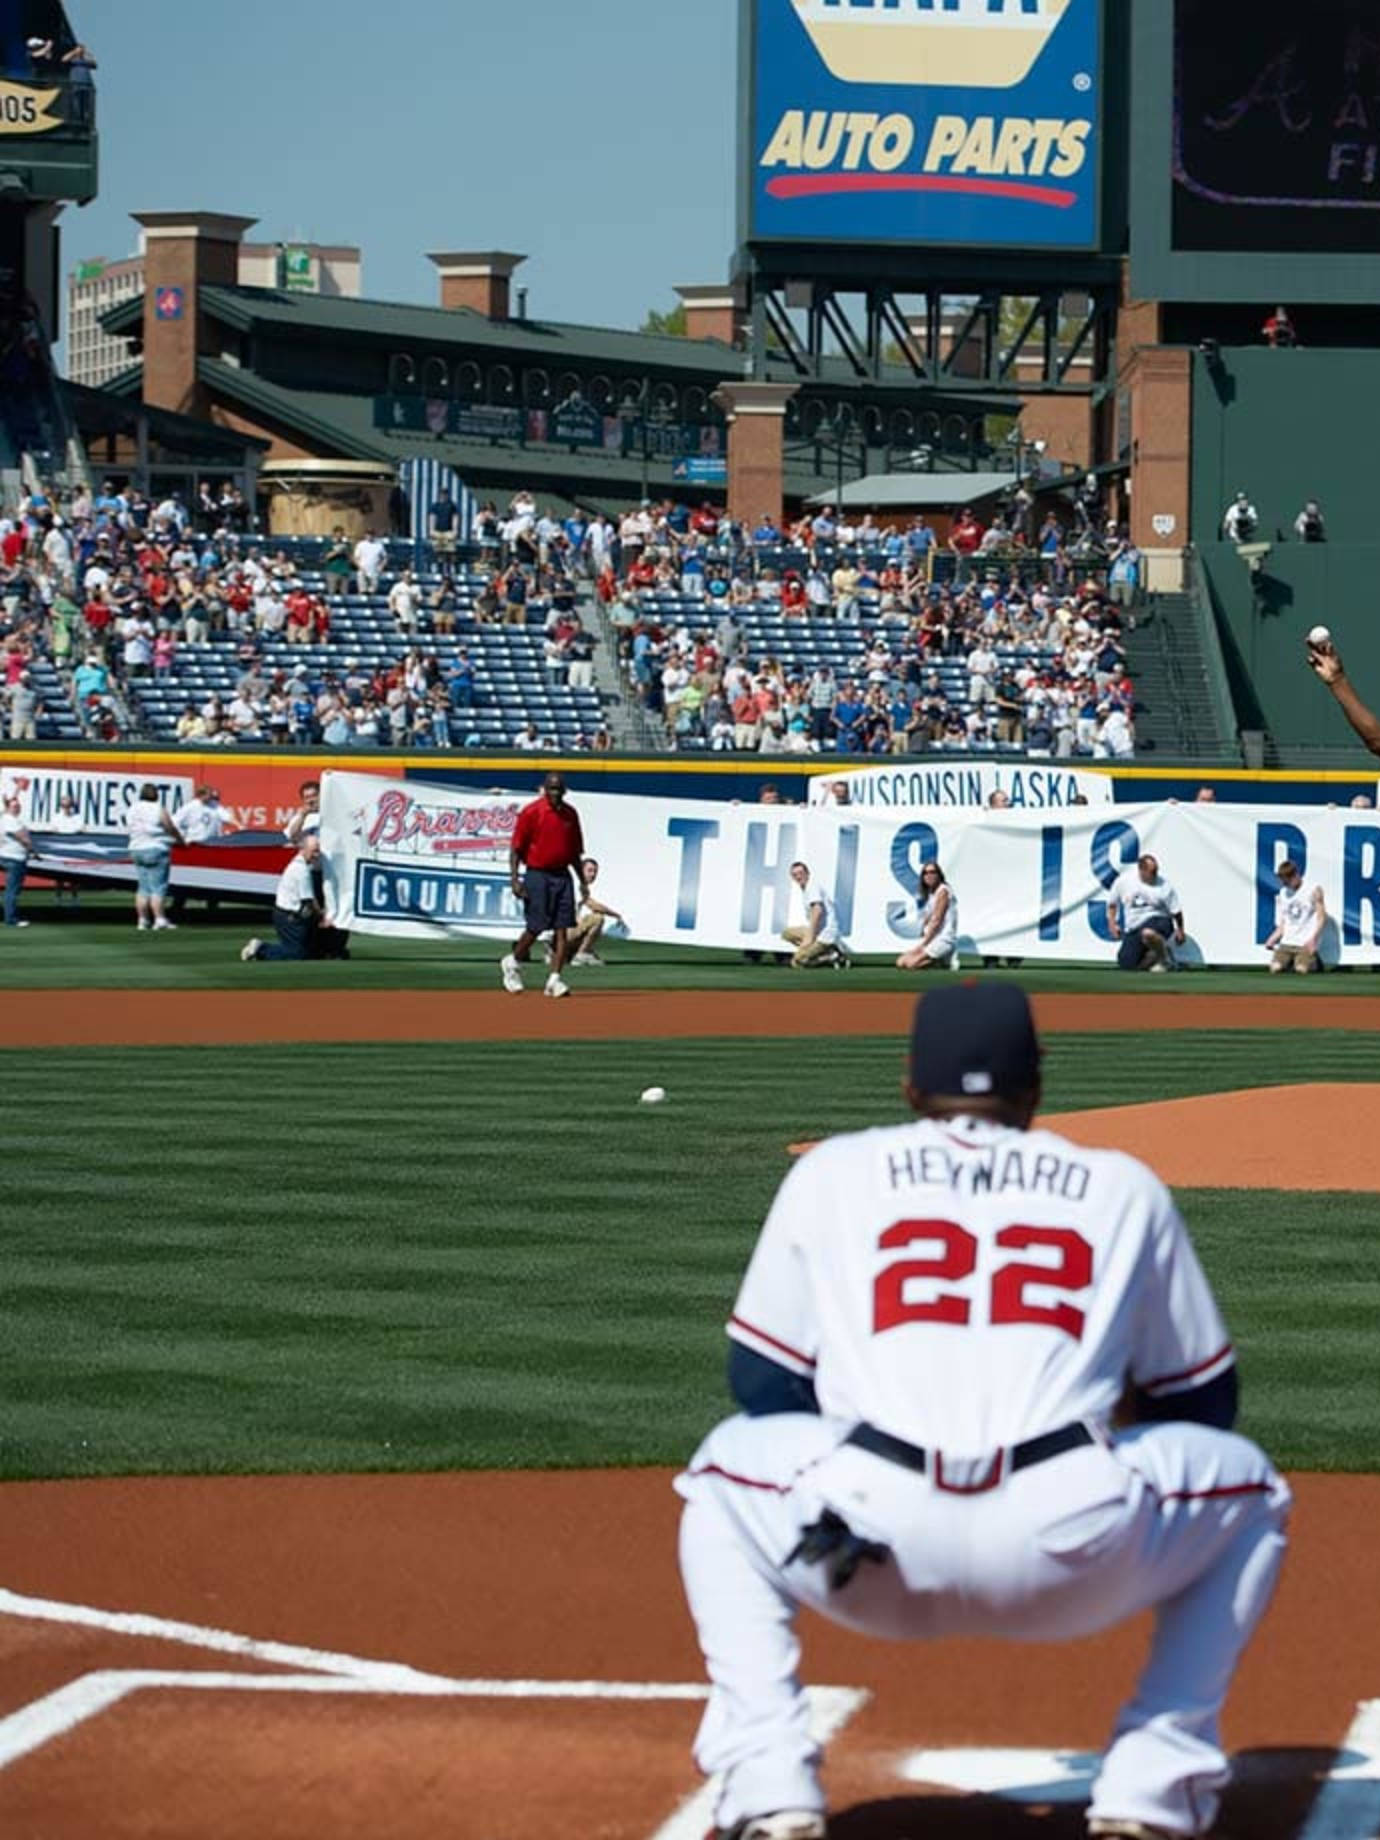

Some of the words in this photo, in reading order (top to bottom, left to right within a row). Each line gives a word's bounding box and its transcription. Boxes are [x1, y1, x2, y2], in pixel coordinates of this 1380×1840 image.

[0, 95, 37, 123] 05
[760, 110, 914, 173] AUTO
[922, 115, 1092, 178] PARTS
[30, 776, 186, 828] MINNESTA
[994, 770, 1089, 809] ASKA
[371, 873, 524, 918] COUNTR
[667, 816, 939, 940] THIS
[1038, 820, 1140, 941] IS
[888, 1146, 1091, 1201] HEYWARD
[872, 1218, 1094, 1343] 22
